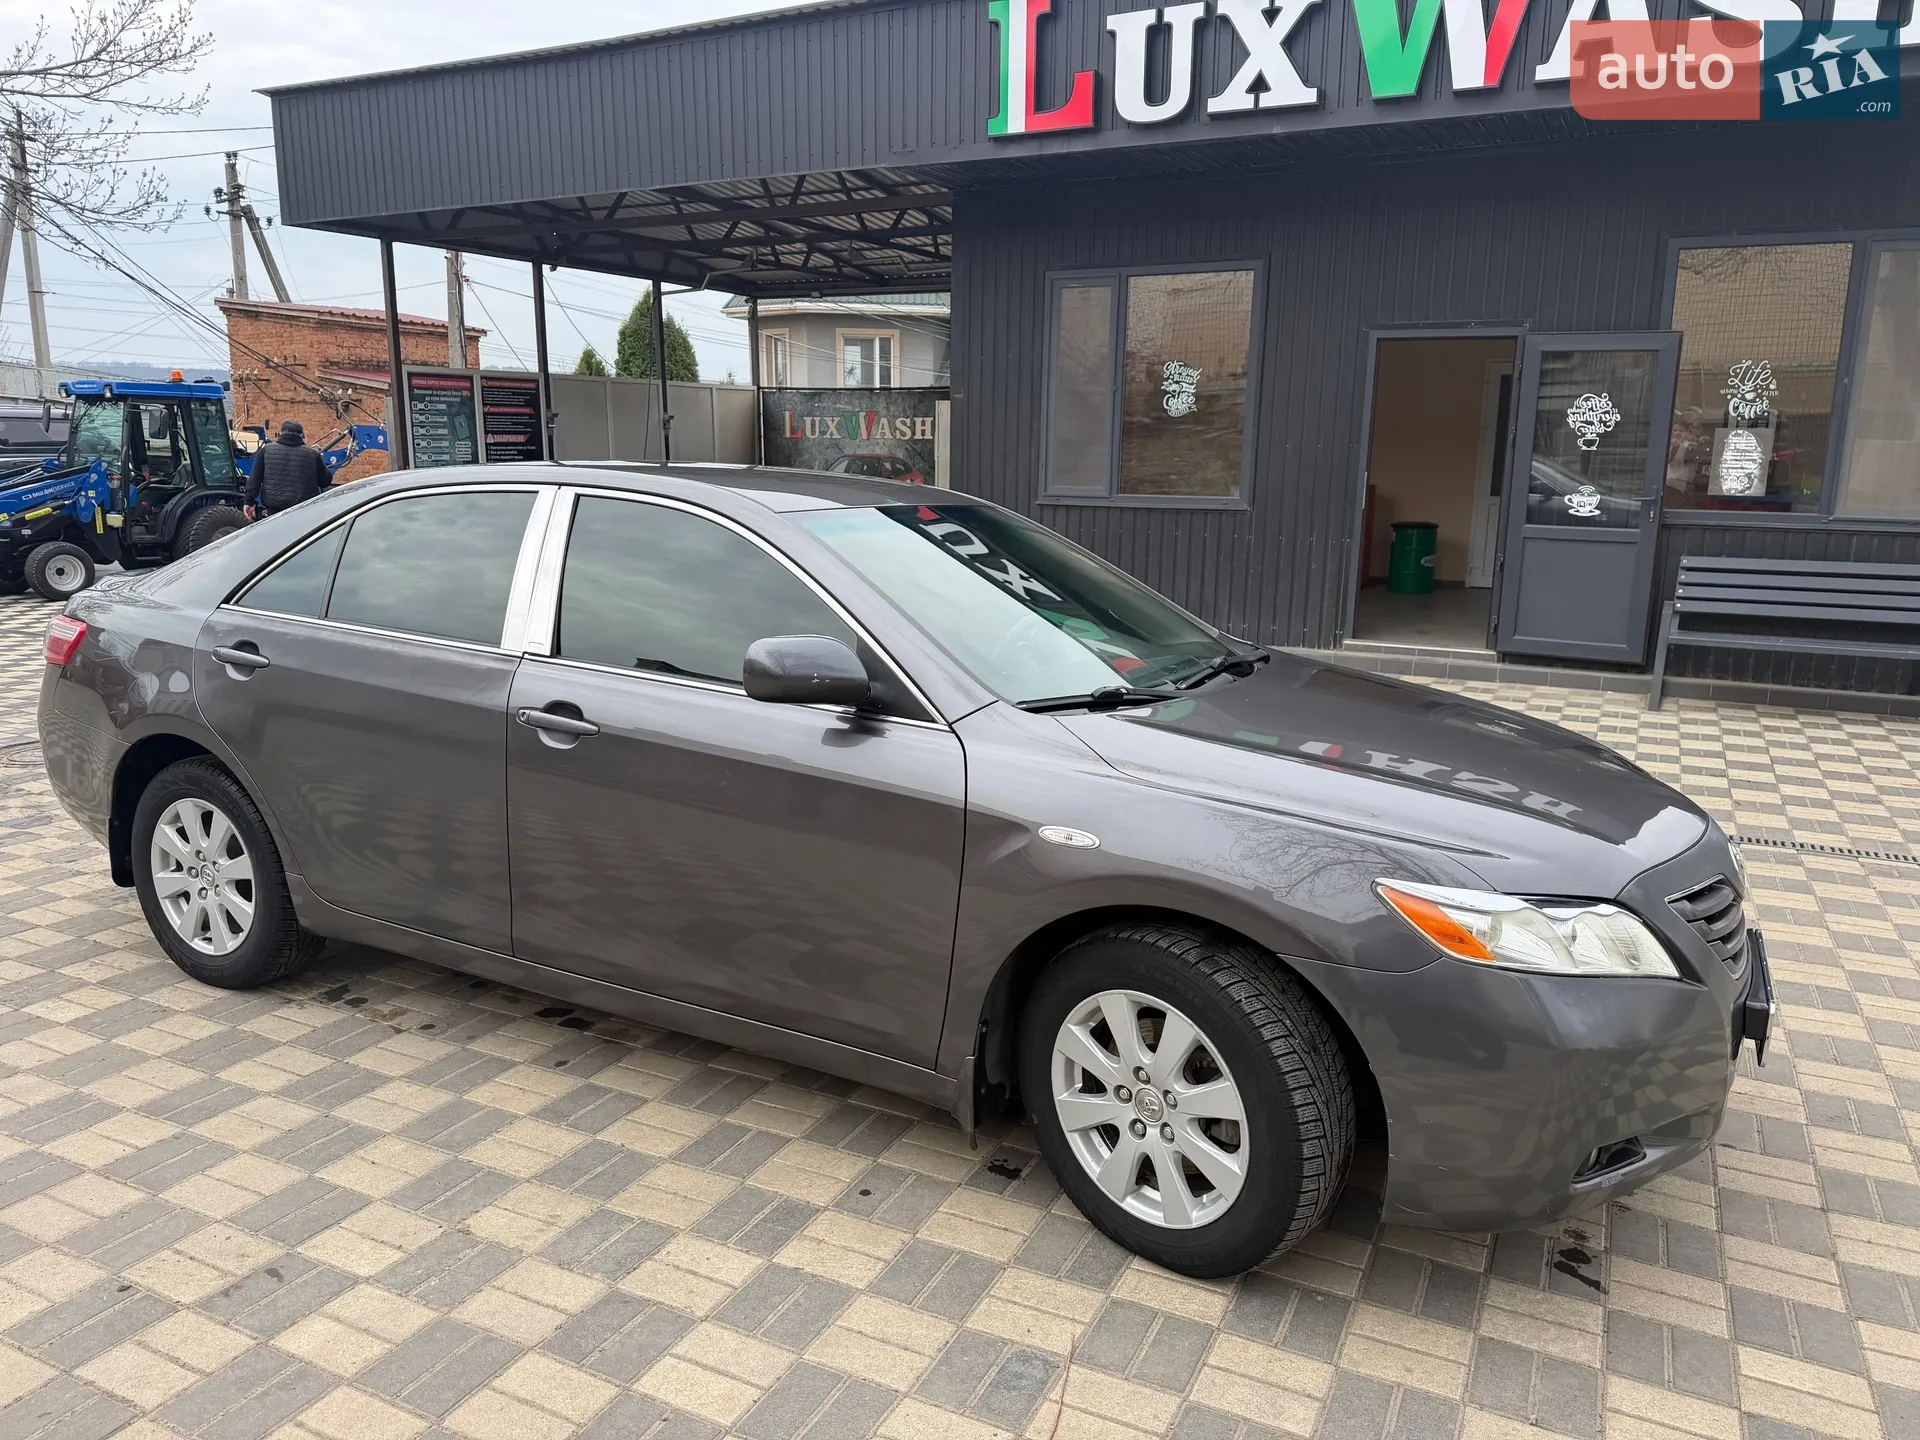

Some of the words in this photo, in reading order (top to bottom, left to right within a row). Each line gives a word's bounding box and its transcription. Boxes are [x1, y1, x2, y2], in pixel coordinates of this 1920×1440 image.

[1728, 360, 1772, 393] Life
[1163, 391, 1196, 409] Coffee
[1728, 398, 1770, 419] Coffee
